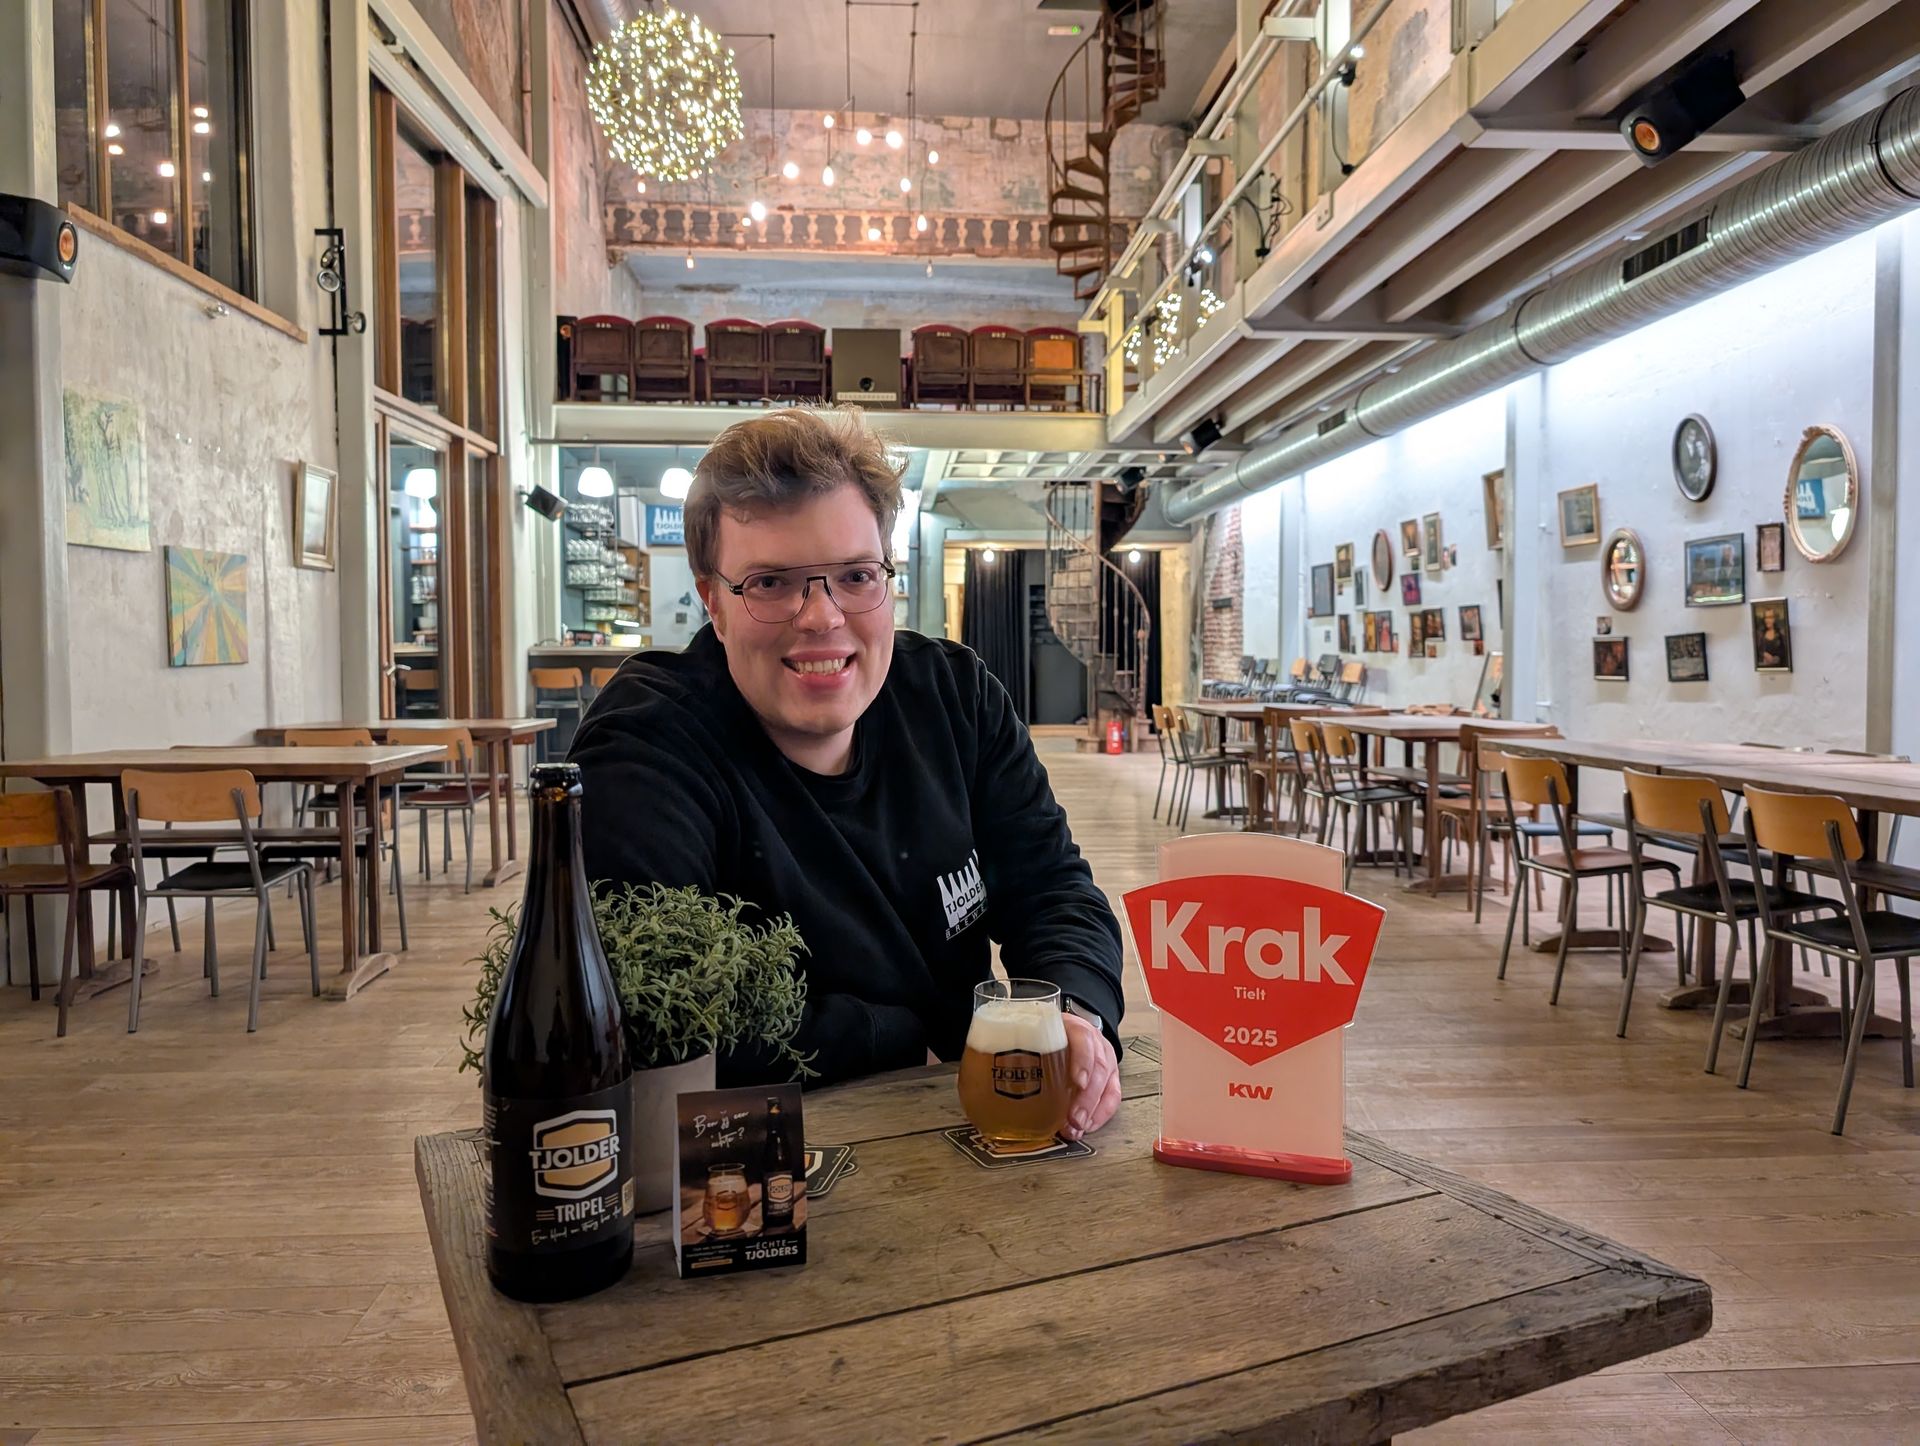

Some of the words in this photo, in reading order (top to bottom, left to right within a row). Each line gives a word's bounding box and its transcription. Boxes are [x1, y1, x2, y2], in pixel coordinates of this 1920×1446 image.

[1150, 899, 1355, 986] Krak
[1233, 986, 1266, 1001] Tielt
[1223, 1025, 1278, 1048] 2025
[992, 1067, 1044, 1080] TJOLDER
[1228, 1082, 1273, 1101] KW
[528, 1135, 621, 1169] TJOLDER
[555, 1196, 605, 1223] TRIPEL
[745, 1245, 799, 1261] TJOLDERS
